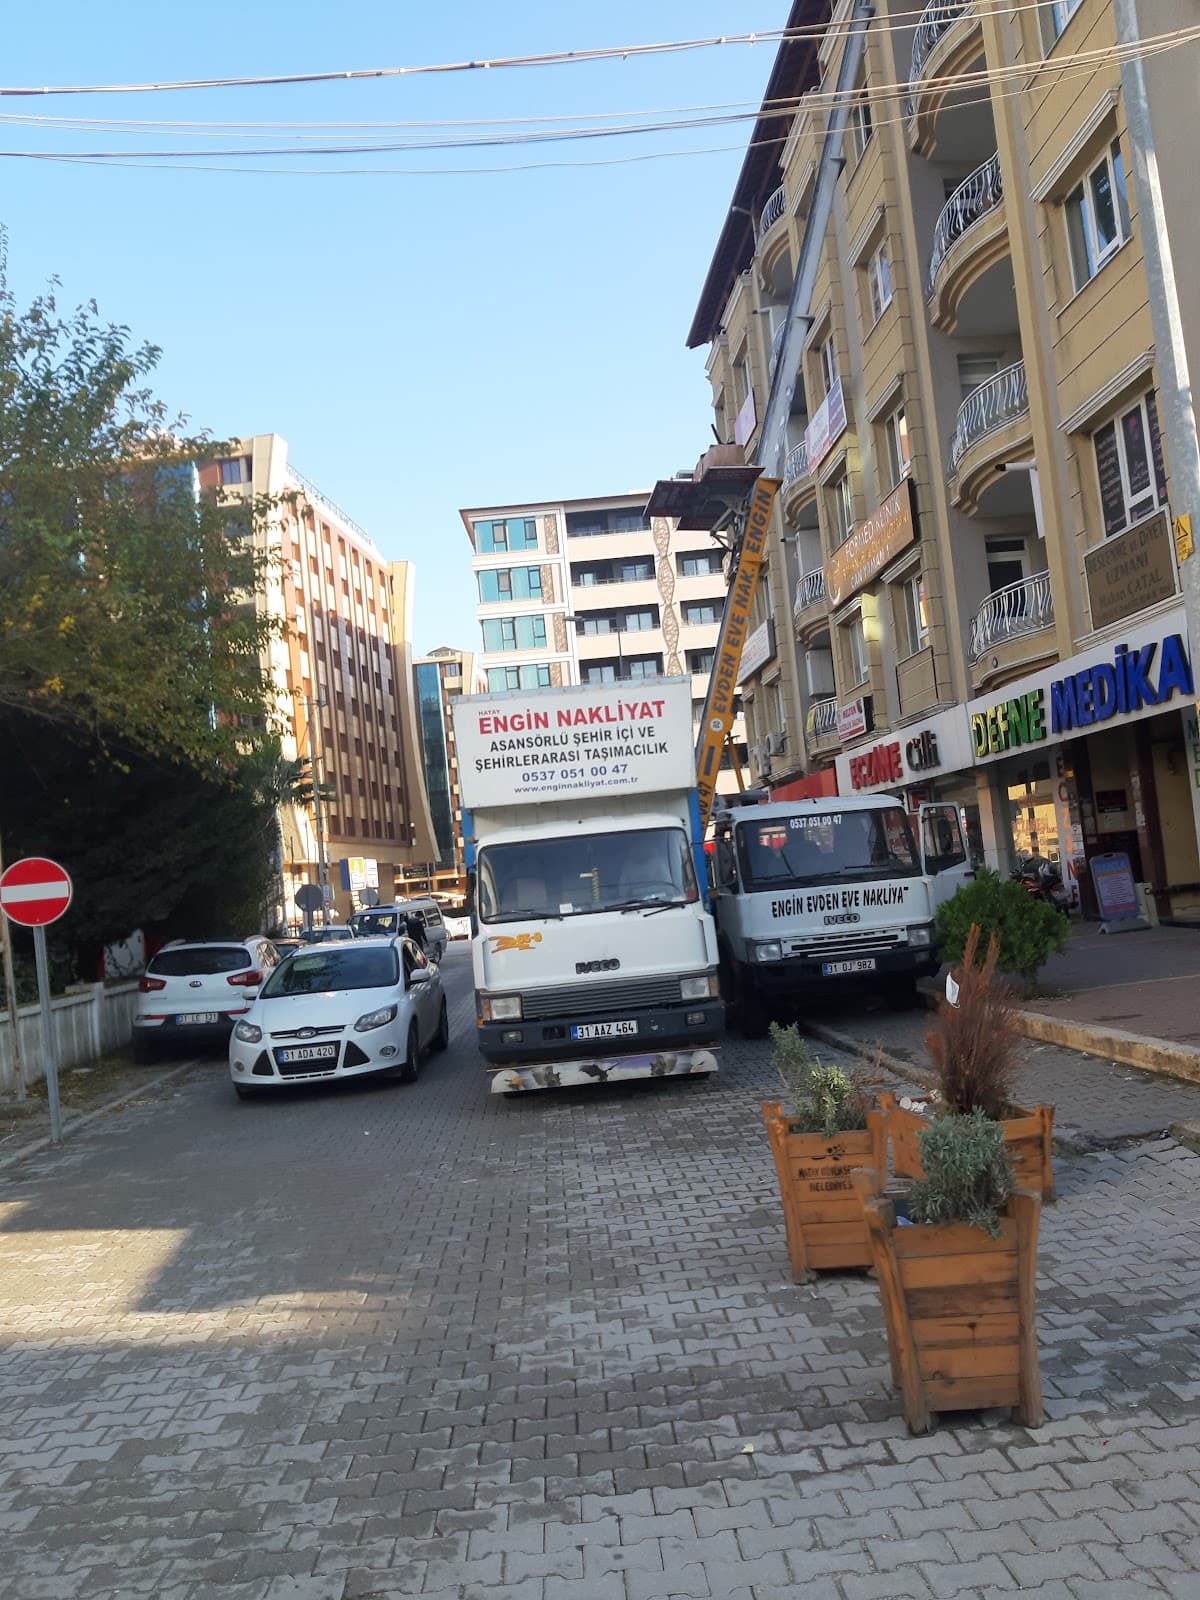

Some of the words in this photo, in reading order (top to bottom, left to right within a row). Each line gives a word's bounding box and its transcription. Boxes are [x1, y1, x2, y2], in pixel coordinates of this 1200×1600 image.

[713, 652, 737, 714] EVDEN
[725, 615, 746, 647] EVE
[747, 488, 772, 555] ENGİN
[971, 688, 1047, 757] DEFNE
[1050, 633, 1194, 734] MEDİKA
[479, 709, 549, 734] ENGİN
[556, 700, 665, 727] NAKLİYAT
[490, 732, 568, 752] ASANSÖRLÜ
[573, 727, 612, 747] ŞEHİR
[617, 725, 634, 742] İÇİ
[638, 726, 655, 738] VE
[475, 750, 580, 773] ŞEHİRLERARASI
[584, 742, 668, 762] TAŞIMACILIK
[522, 770, 555, 782] 0537
[560, 768, 585, 779] 051
[590, 766, 607, 776] 00
[612, 764, 628, 774] 47
[514, 777, 638, 793] www.enginnakliyat.com.tr
[790, 817, 807, 829] 0537
[808, 816, 821, 827] 051
[822, 815, 832, 825] 00
[833, 814, 842, 825] 47
[771, 893, 804, 918] ENGİN
[807, 892, 839, 913] EVDEN
[842, 890, 860, 908] EVE
[823, 913, 861, 925] IVECO
[575, 958, 621, 974] IVECO
[578, 1026, 590, 1038] 31
[594, 1024, 612, 1037] AAZ
[616, 1022, 634, 1033] 464
[284, 1051, 295, 1060] 31
[298, 1049, 314, 1058] ADA
[317, 1046, 333, 1056] 420
